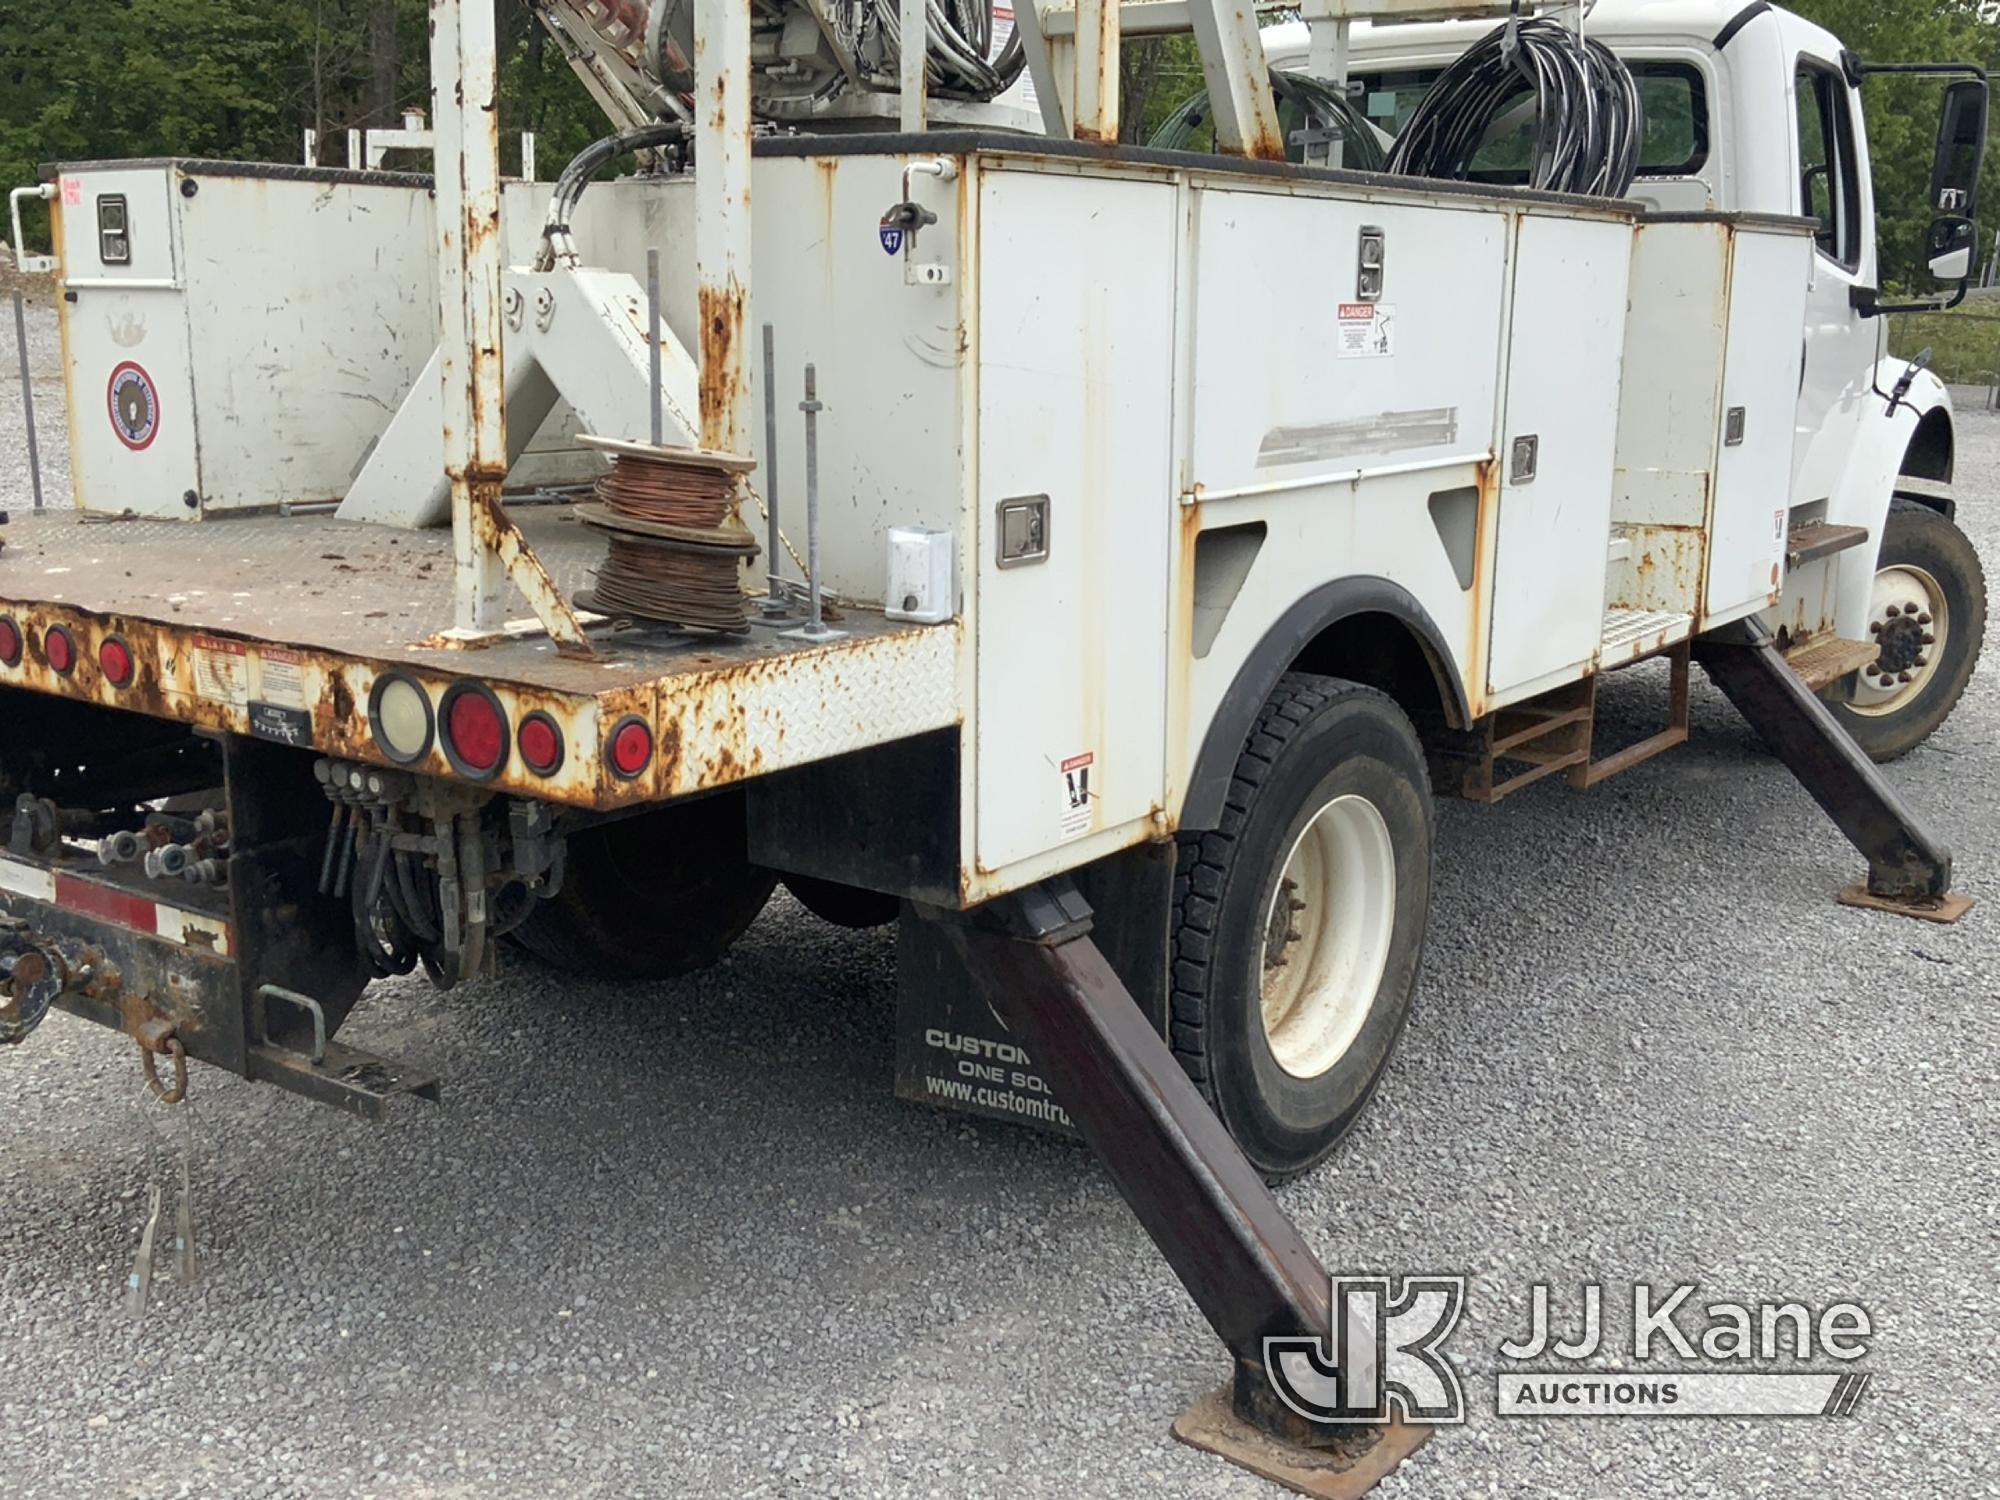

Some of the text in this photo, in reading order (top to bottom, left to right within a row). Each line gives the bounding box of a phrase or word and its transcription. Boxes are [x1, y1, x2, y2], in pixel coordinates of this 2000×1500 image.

[884, 232, 899, 248] 47
[958, 1060, 1005, 1084] ONE
[925, 1075, 1076, 1128] www.customtru
